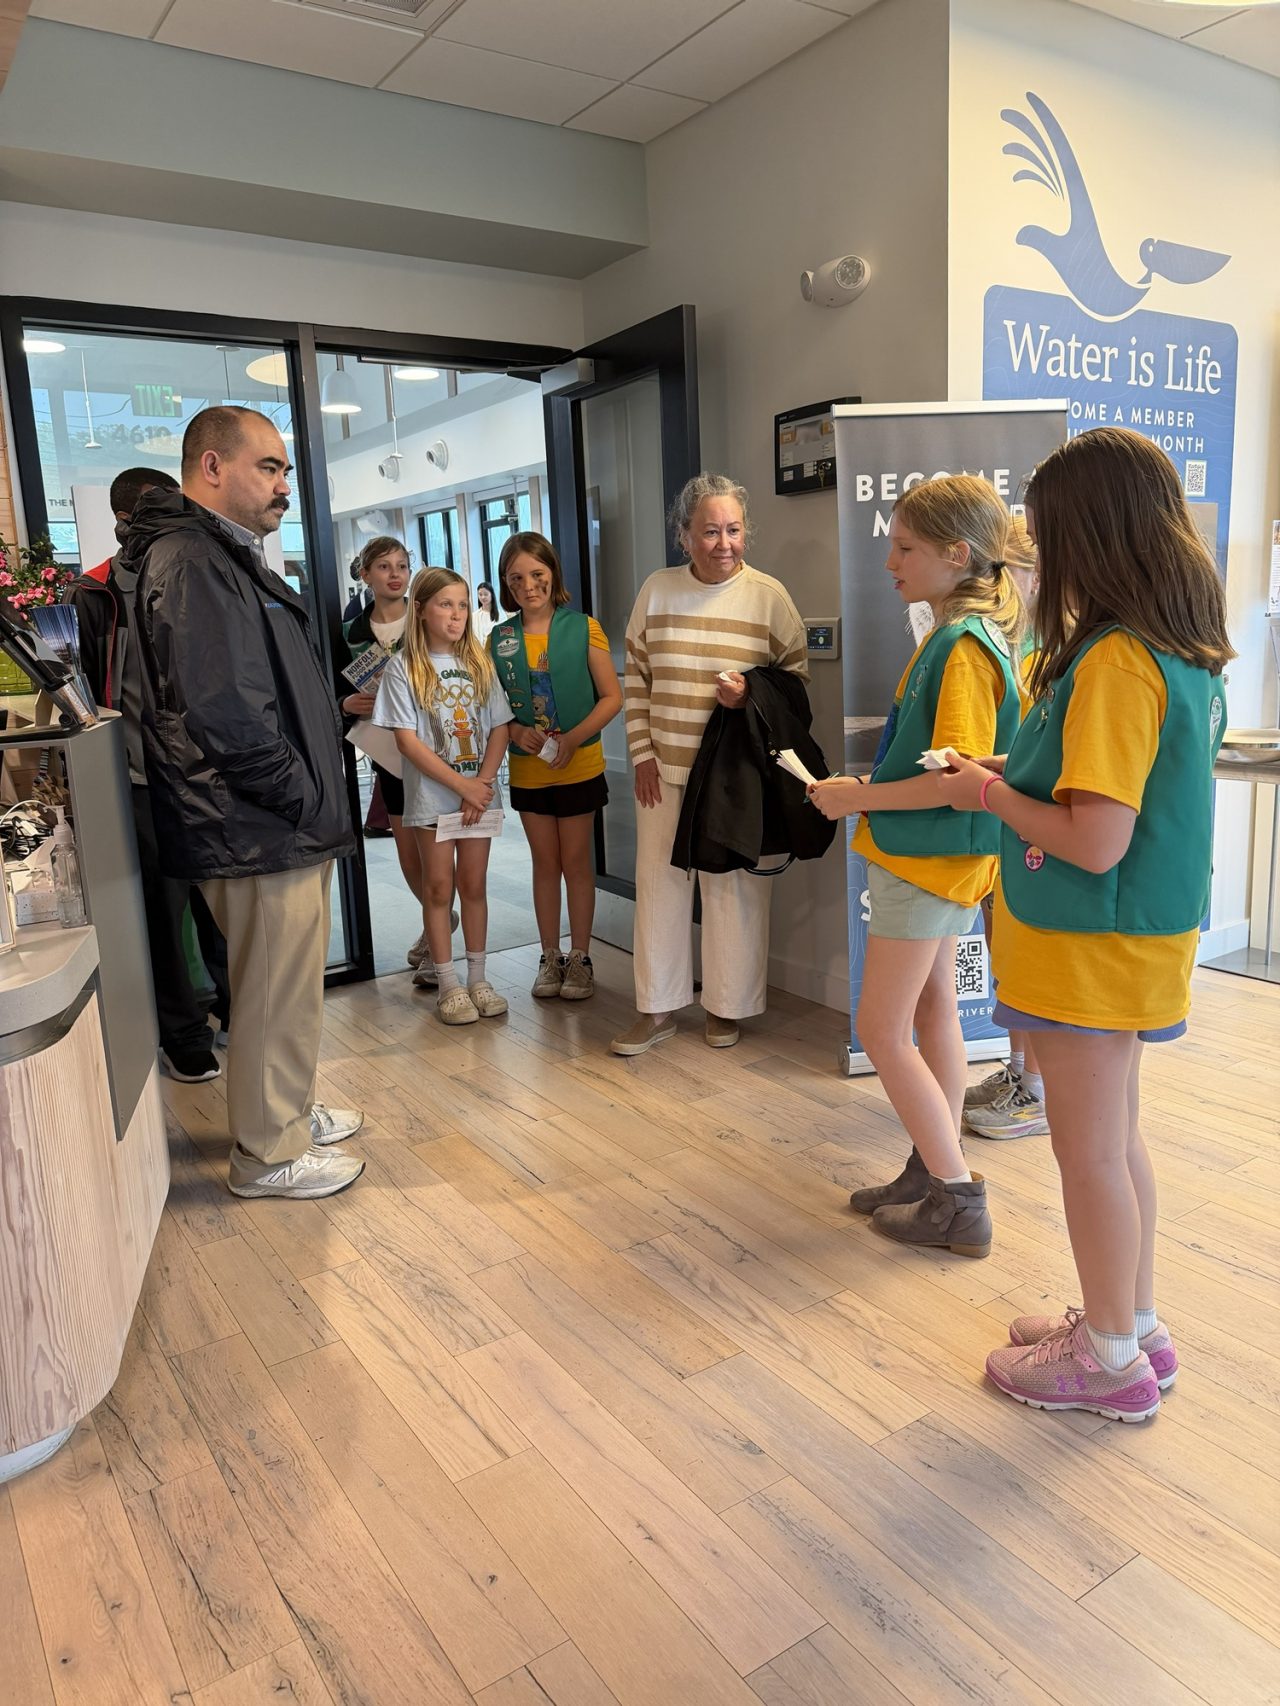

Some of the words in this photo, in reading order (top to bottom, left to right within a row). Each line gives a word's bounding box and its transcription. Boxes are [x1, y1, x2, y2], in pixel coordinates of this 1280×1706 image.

[1003, 320, 1118, 382] Water
[1127, 336, 1154, 387] is
[1164, 344, 1222, 394] Life
[1068, 401, 1107, 421] OME
[1113, 405, 1124, 422] A
[1131, 407, 1195, 428] MEMBER
[1151, 434, 1204, 453] MONTH
[346, 649, 375, 675] NORFOLK
